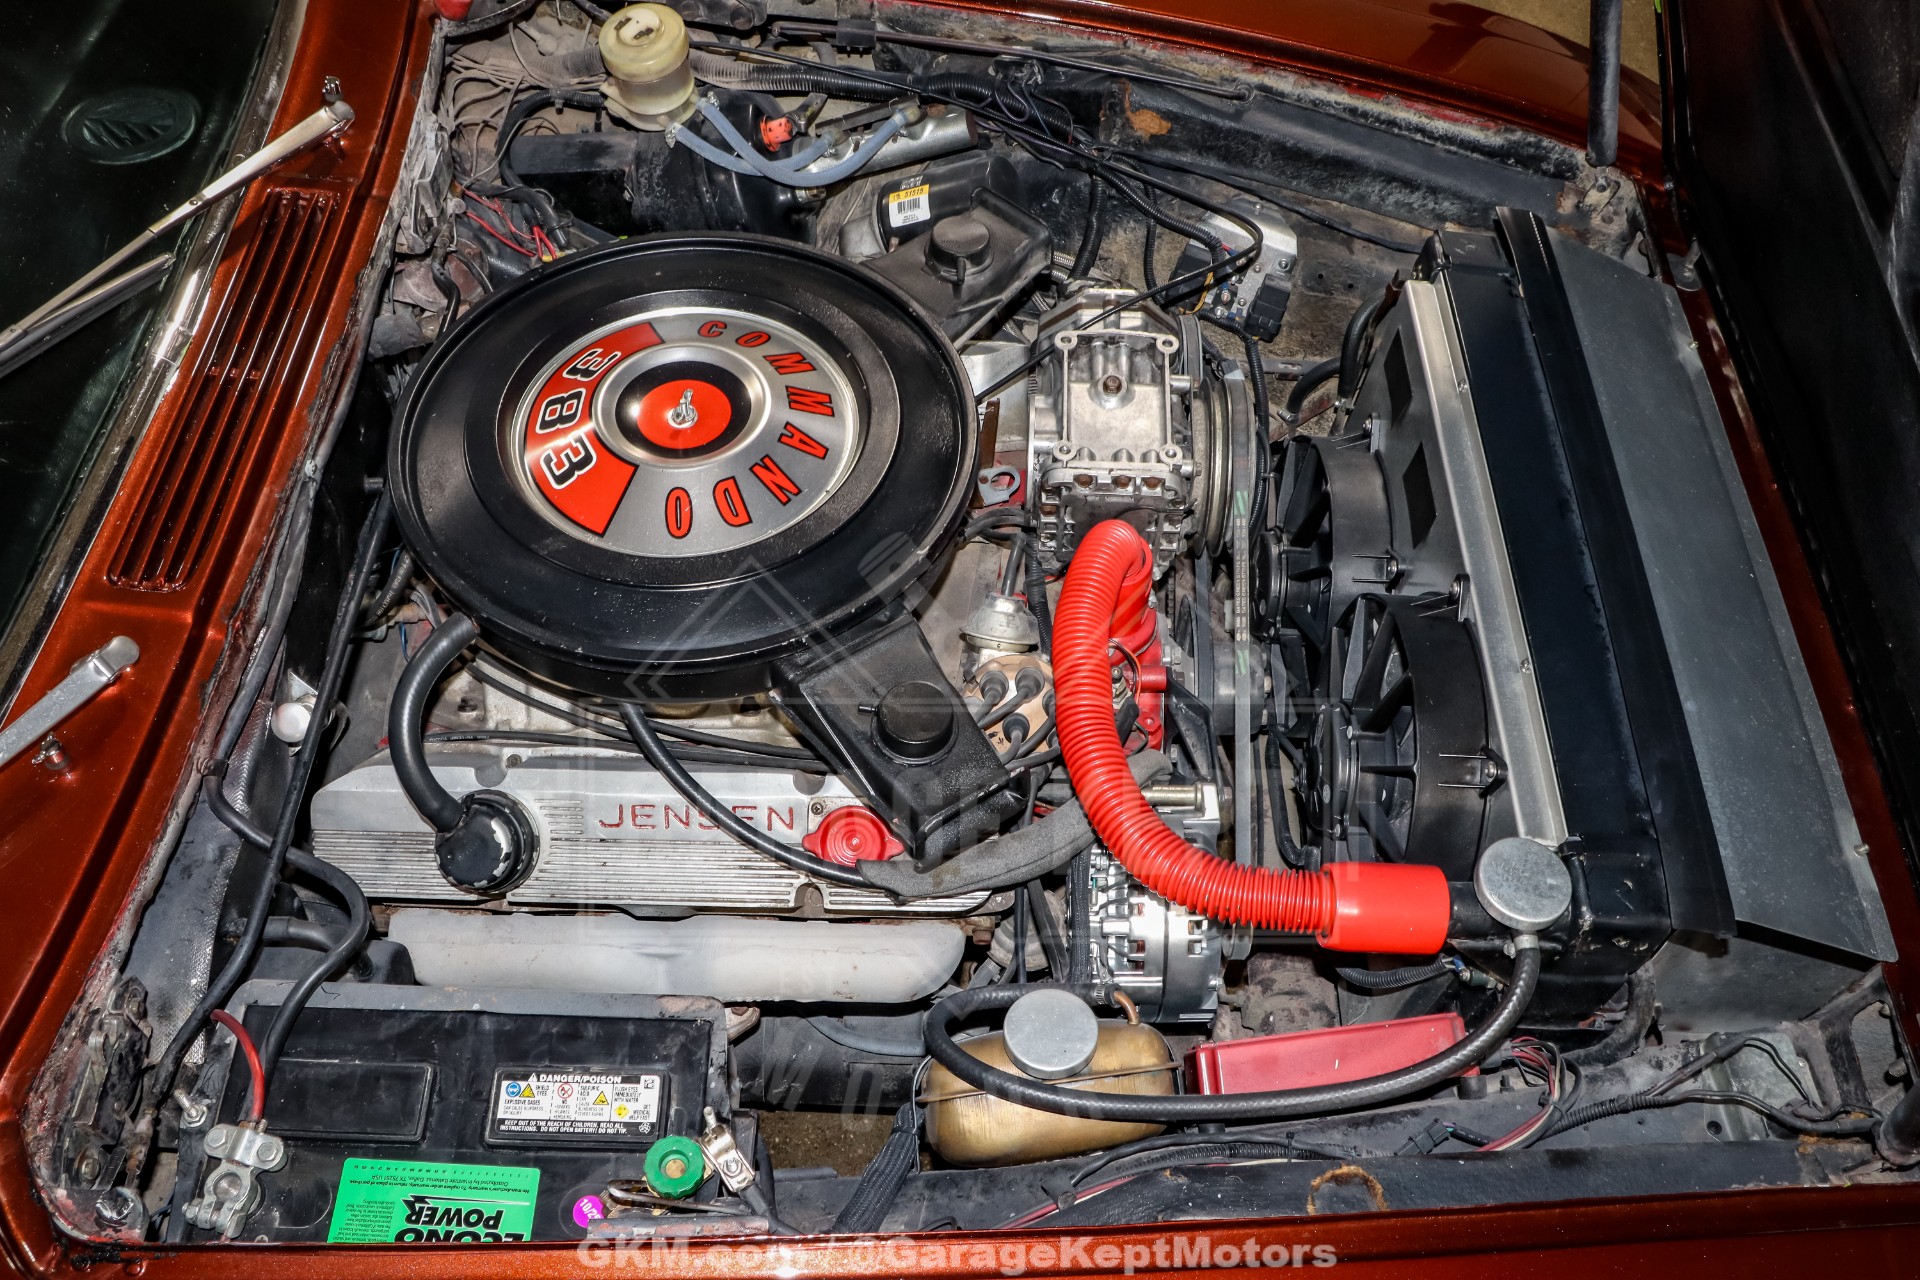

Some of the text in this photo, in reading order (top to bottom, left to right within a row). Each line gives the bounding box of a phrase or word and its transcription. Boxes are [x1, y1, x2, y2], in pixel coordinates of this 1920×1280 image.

[536, 348, 621, 490] 383
[665, 320, 835, 539] COMMANDO
[540, 1074, 622, 1084] DANGER/POISON
[402, 1200, 504, 1230] POWER
